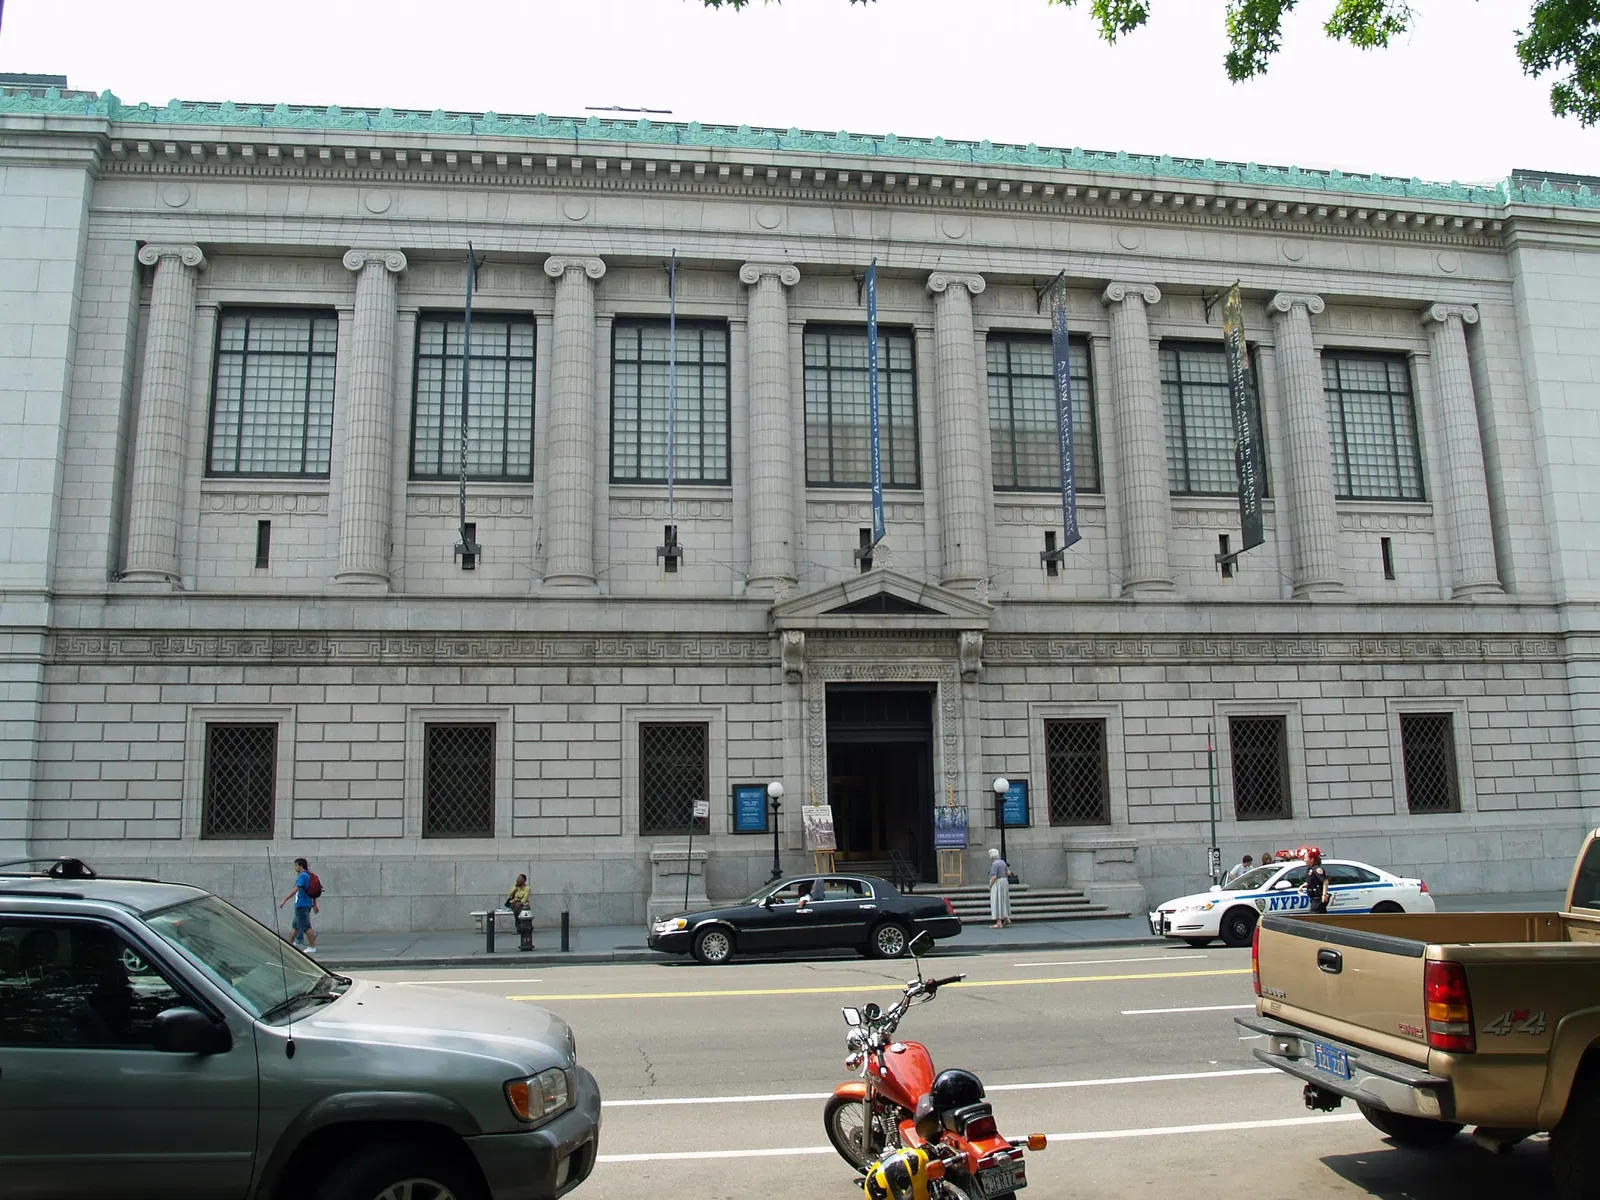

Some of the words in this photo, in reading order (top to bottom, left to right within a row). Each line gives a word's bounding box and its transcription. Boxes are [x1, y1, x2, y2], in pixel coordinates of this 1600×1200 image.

[1241, 411, 1250, 445] ASHER
[1065, 452, 1071, 472] ON
[1269, 895, 1310, 911] NYPD
